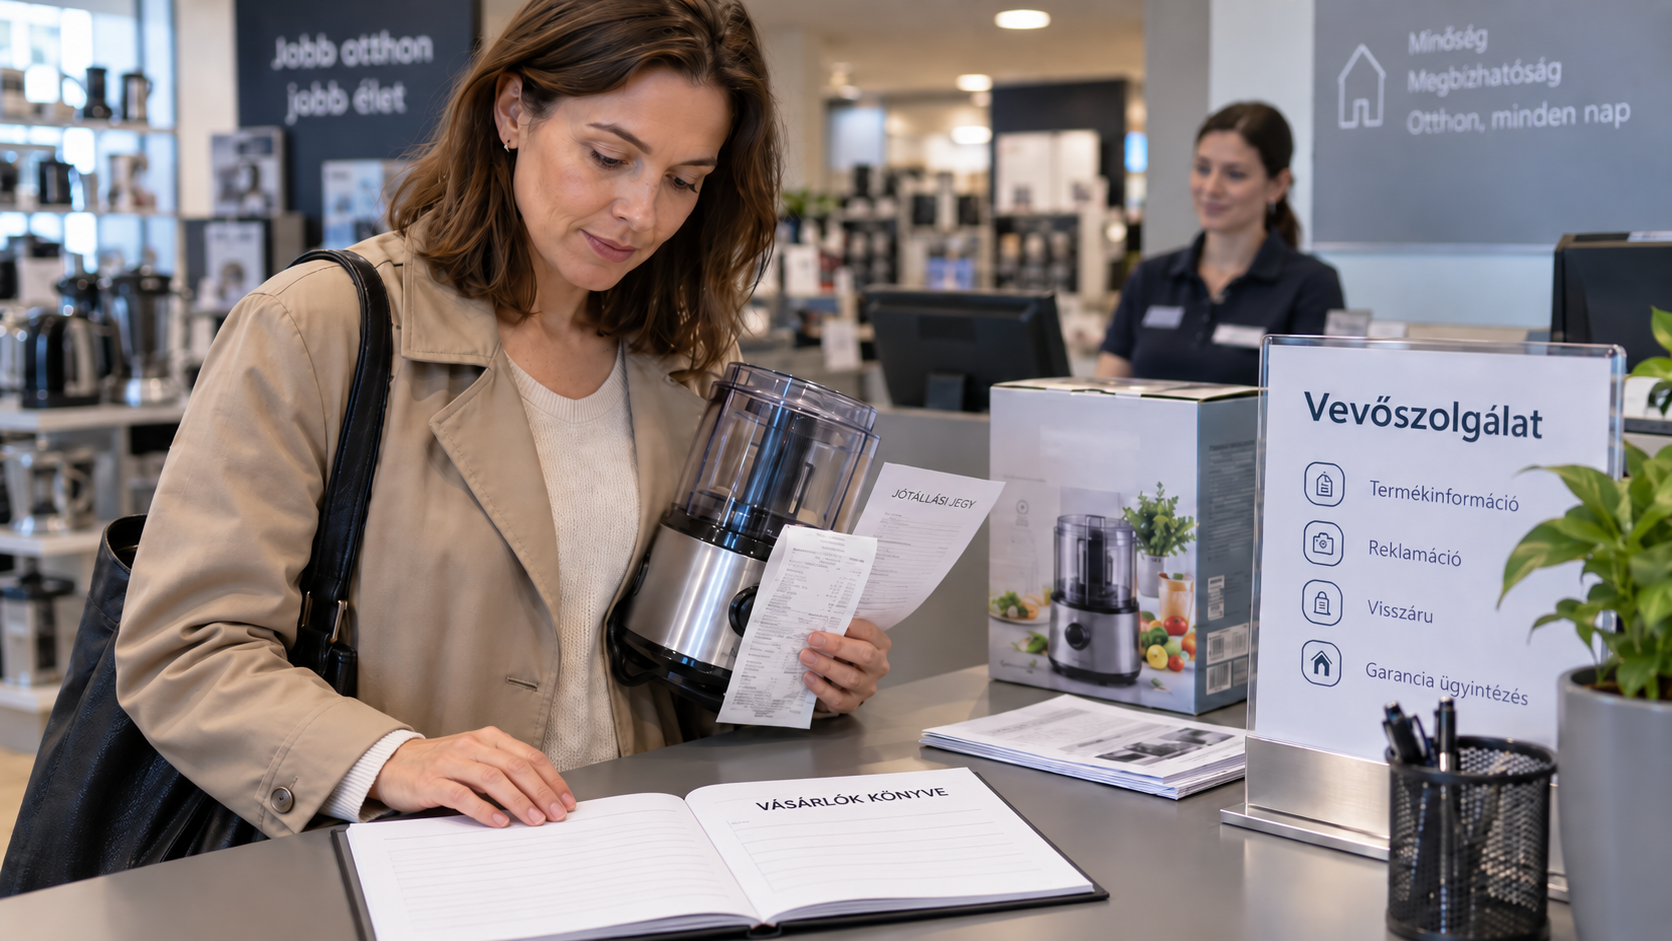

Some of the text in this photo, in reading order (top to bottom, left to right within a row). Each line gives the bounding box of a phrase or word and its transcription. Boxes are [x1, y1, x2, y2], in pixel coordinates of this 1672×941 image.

[271, 29, 434, 70] Jobb otthon
[1408, 24, 1489, 54] Minőség
[1407, 56, 1562, 97] Megbízhatóság
[285, 78, 408, 126] jobb élet
[1406, 101, 1631, 135] Otthon, minden nap
[1304, 391, 1543, 443] Vevőszolgálat
[891, 488, 977, 509] JÓTÁLLÁSI JEGY
[1370, 480, 1520, 512] Termékinformáció
[1369, 540, 1462, 567] Reklamáció
[1367, 600, 1434, 624] Visszáru
[1365, 662, 1529, 706] Garancia ügyintézés
[756, 787, 949, 811] VÁSÁRLÓK KÖNYVE
